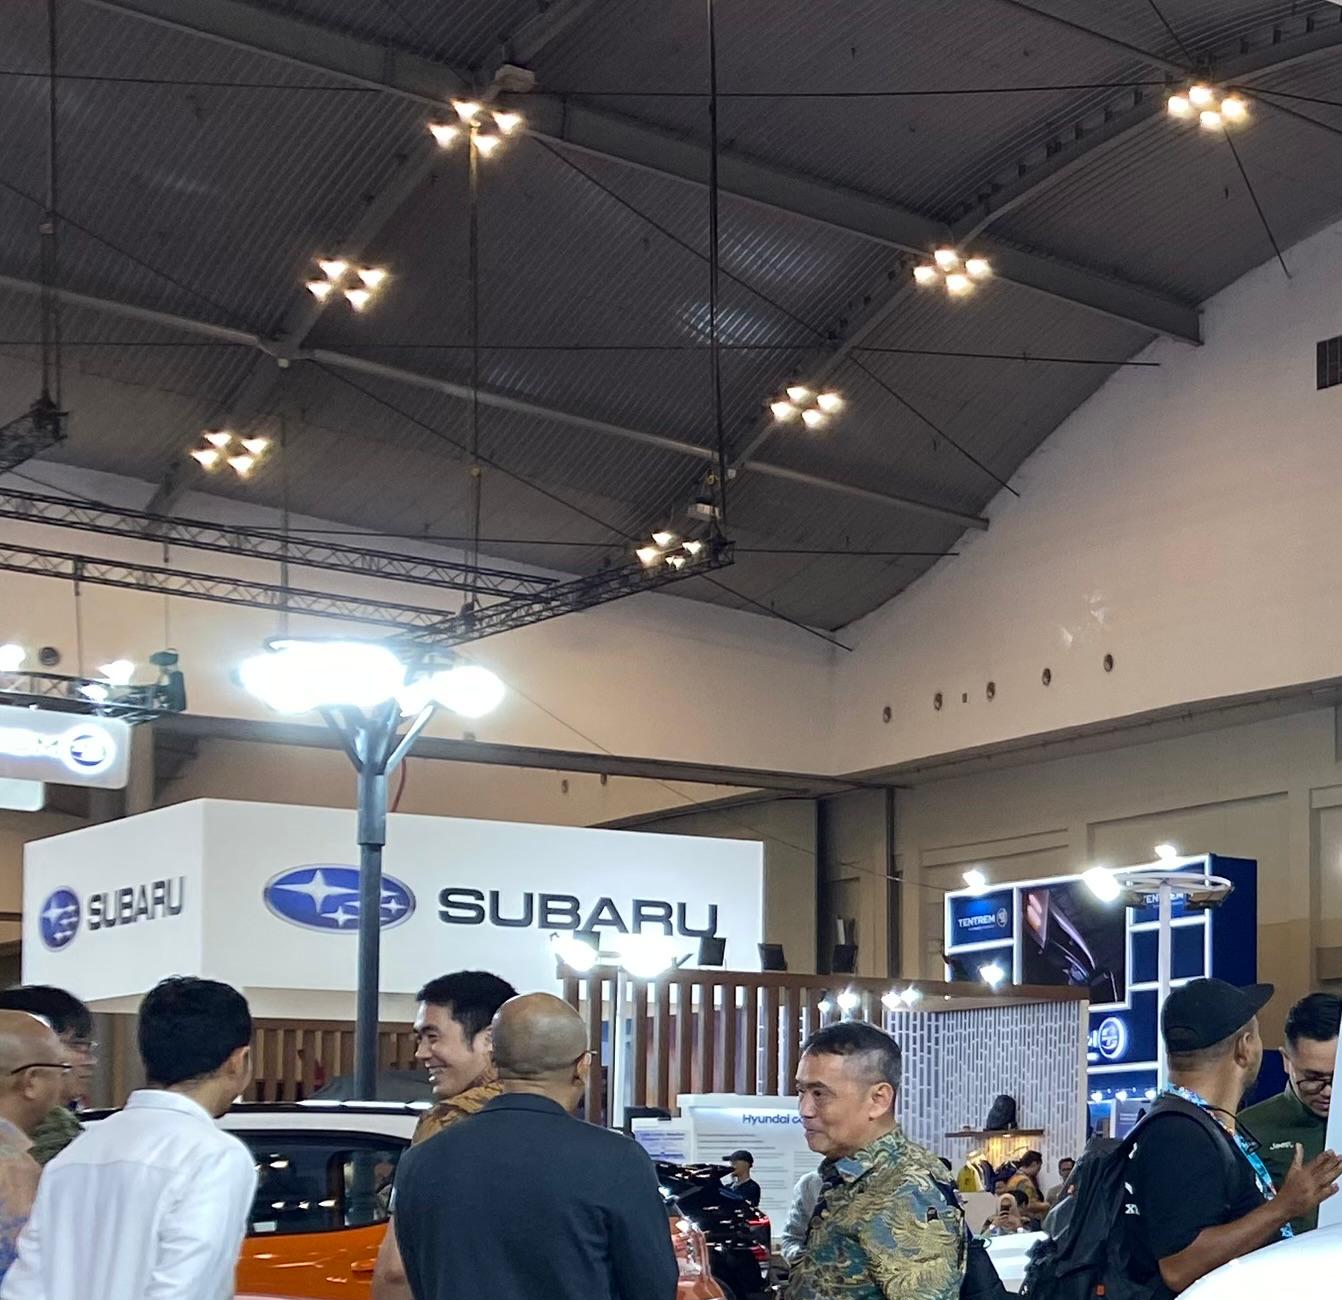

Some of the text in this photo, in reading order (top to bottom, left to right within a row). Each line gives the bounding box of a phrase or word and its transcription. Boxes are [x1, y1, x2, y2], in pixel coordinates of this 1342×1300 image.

[87, 876, 185, 931] SUBARU
[437, 887, 719, 940] SUBARU
[957, 914, 996, 928] TENTREM
[742, 1113, 790, 1126] Hyundai
